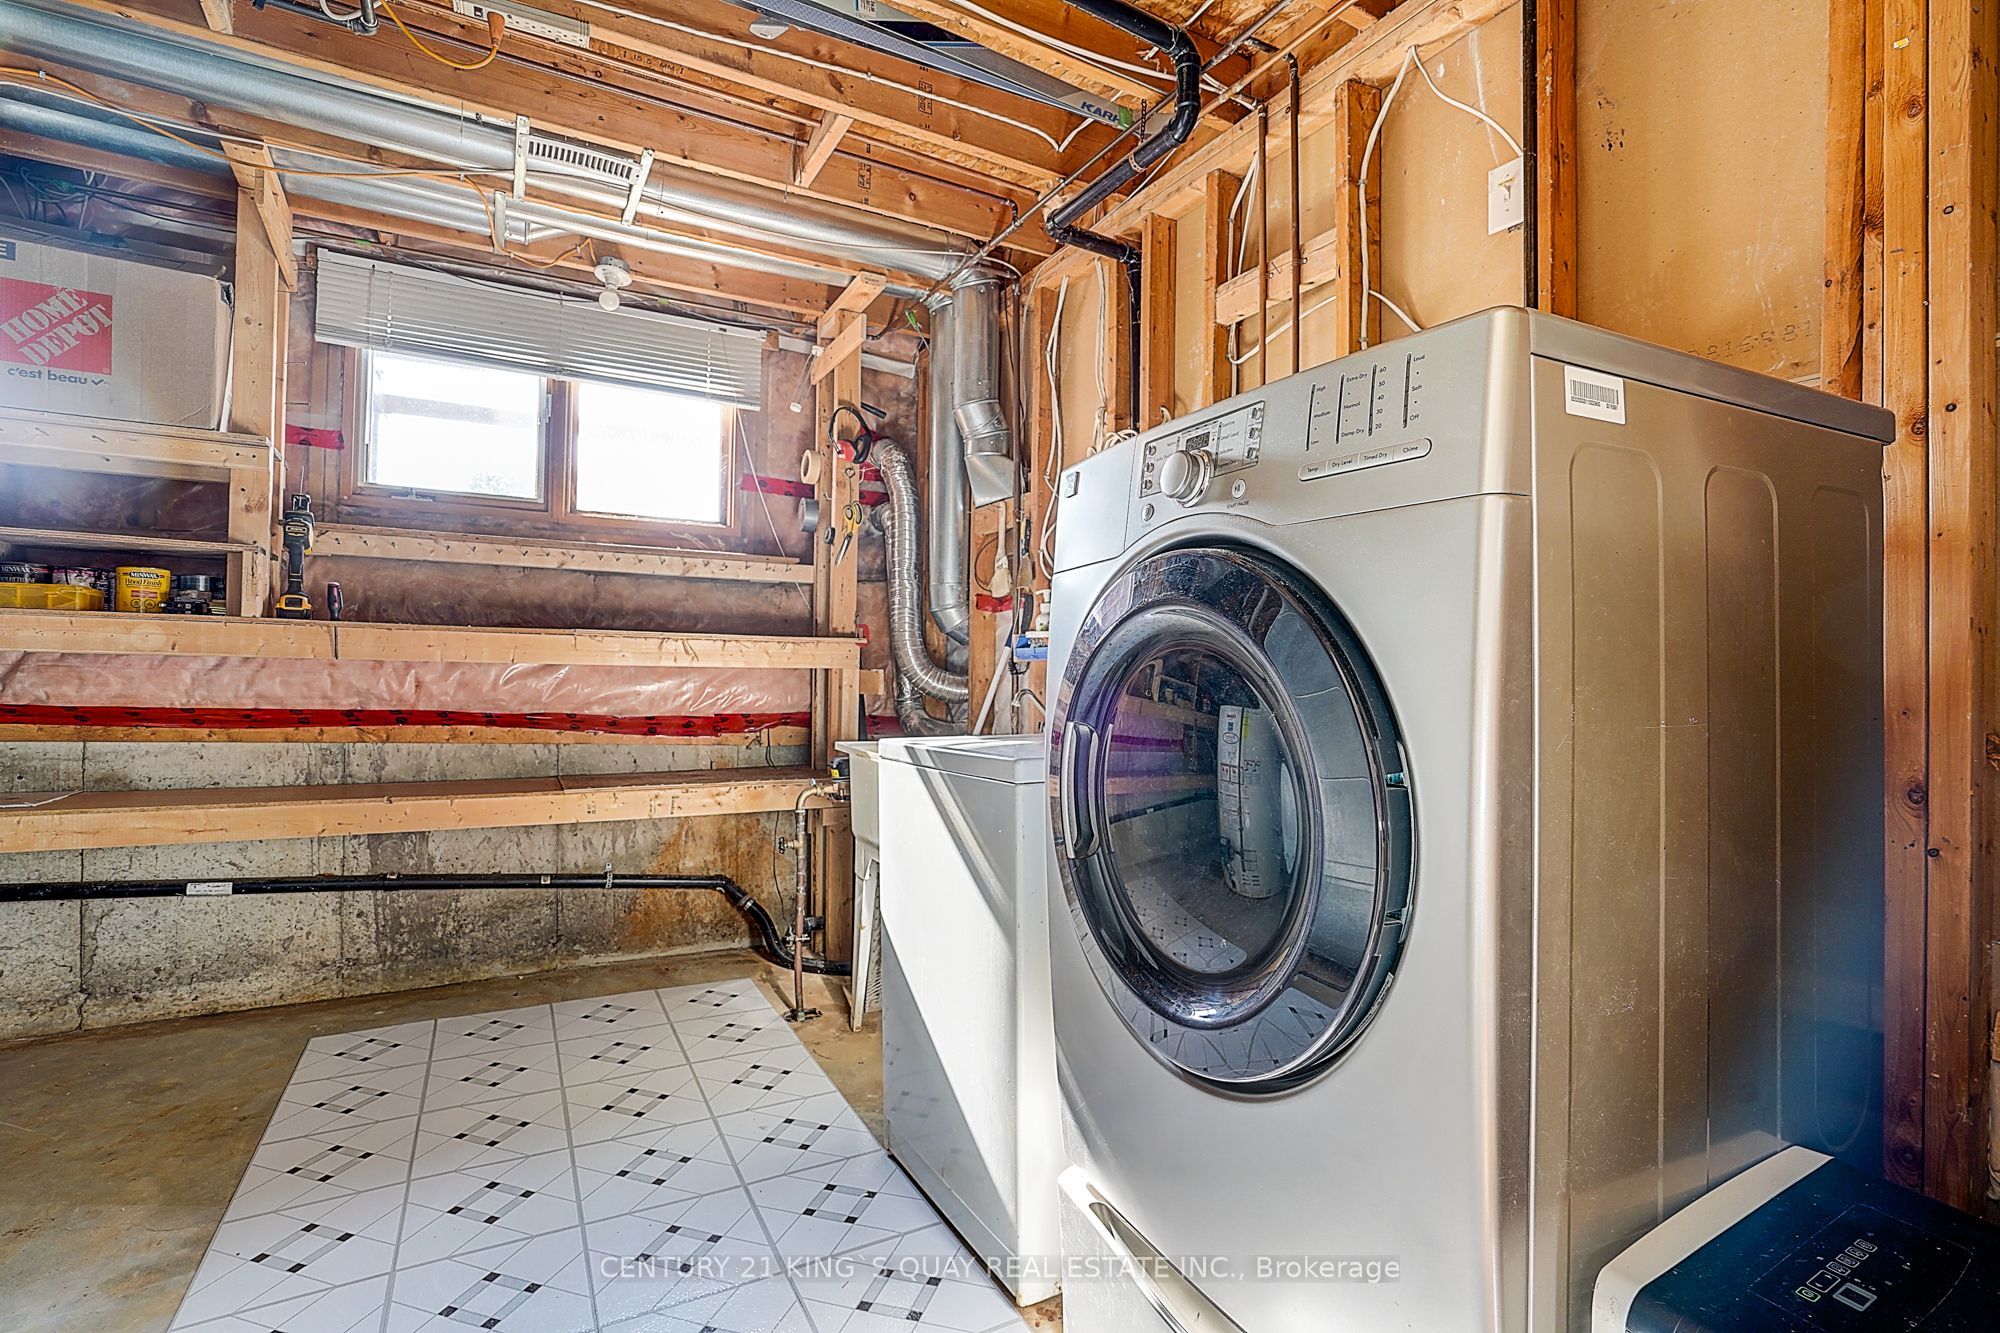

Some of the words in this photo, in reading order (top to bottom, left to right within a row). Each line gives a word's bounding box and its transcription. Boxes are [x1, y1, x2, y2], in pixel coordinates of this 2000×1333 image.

[0, 286, 88, 345] HOME
[18, 303, 113, 366] DEPOT
[7, 366, 43, 382] c'est
[47, 370, 88, 386] beau
[1377, 451, 1388, 460] Dry
[1402, 445, 1419, 453] Chime
[125, 578, 143, 587] Wood
